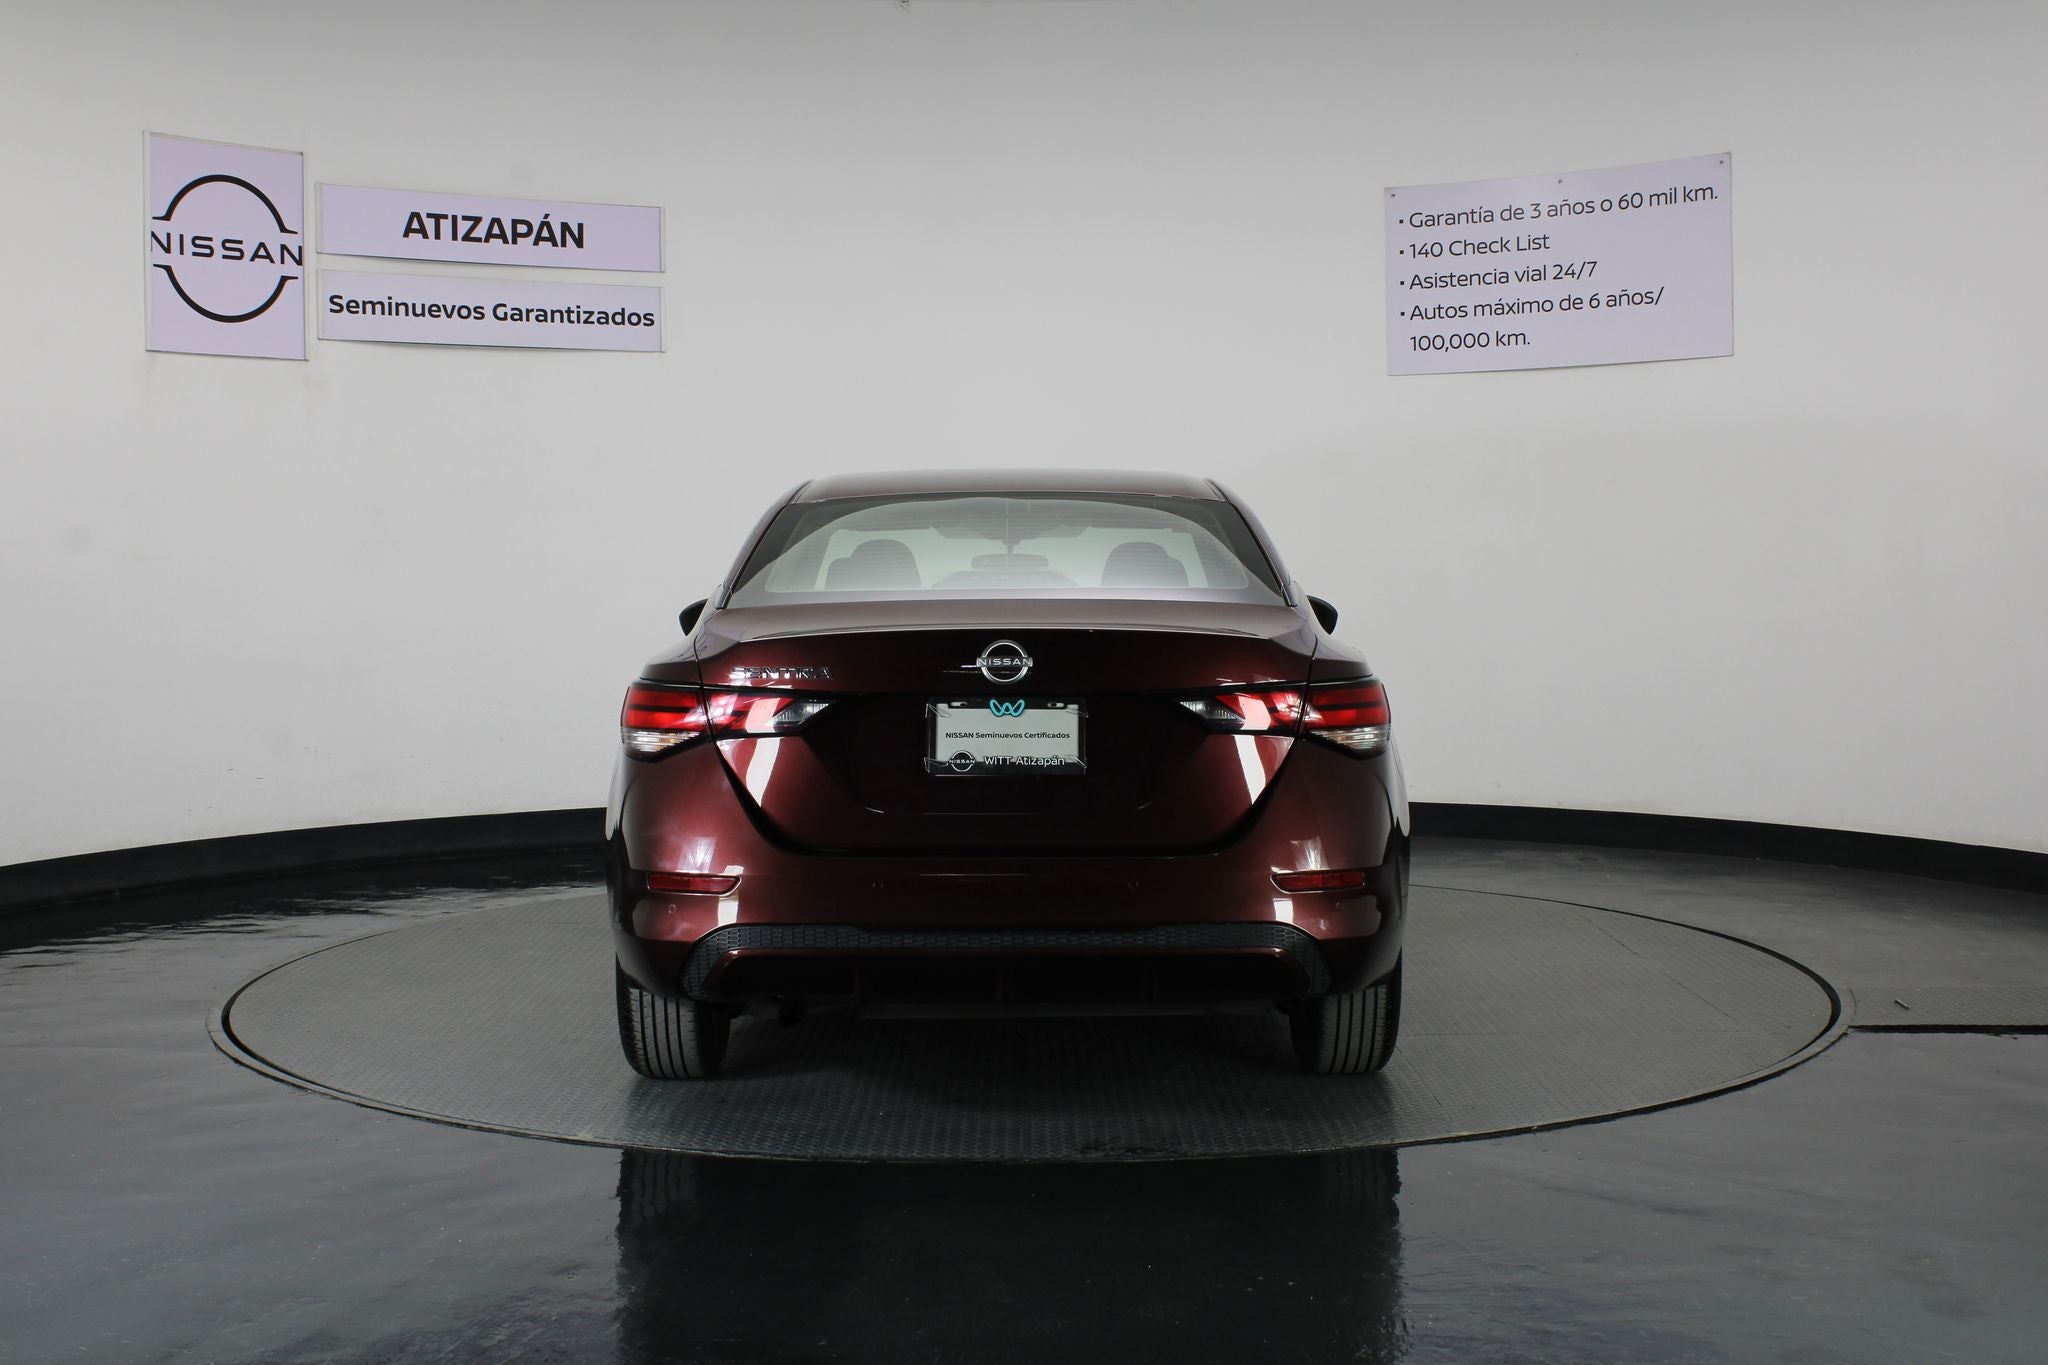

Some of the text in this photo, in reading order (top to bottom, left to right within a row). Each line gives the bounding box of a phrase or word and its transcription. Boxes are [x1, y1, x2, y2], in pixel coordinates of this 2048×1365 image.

[1409, 184, 1718, 228] Garantía de 3 años o 60 mil km.
[402, 210, 585, 249] ATIZAPÁN
[150, 230, 303, 267] NISSAN
[1409, 233, 1550, 259] 140 Check List
[1409, 260, 1598, 290] Asistencia vial 24/7
[329, 294, 655, 328] Seminuevos Garantizados
[1409, 285, 1664, 321] Autos máximo de 6 años/
[1409, 330, 1531, 353] 100,000 km.
[729, 666, 835, 679] SENTRA
[977, 657, 1033, 666] NISSAN
[975, 731, 1023, 739] Seminuevos
[1024, 731, 1070, 739] Certificados
[983, 755, 1065, 767] WITT Atizapán
